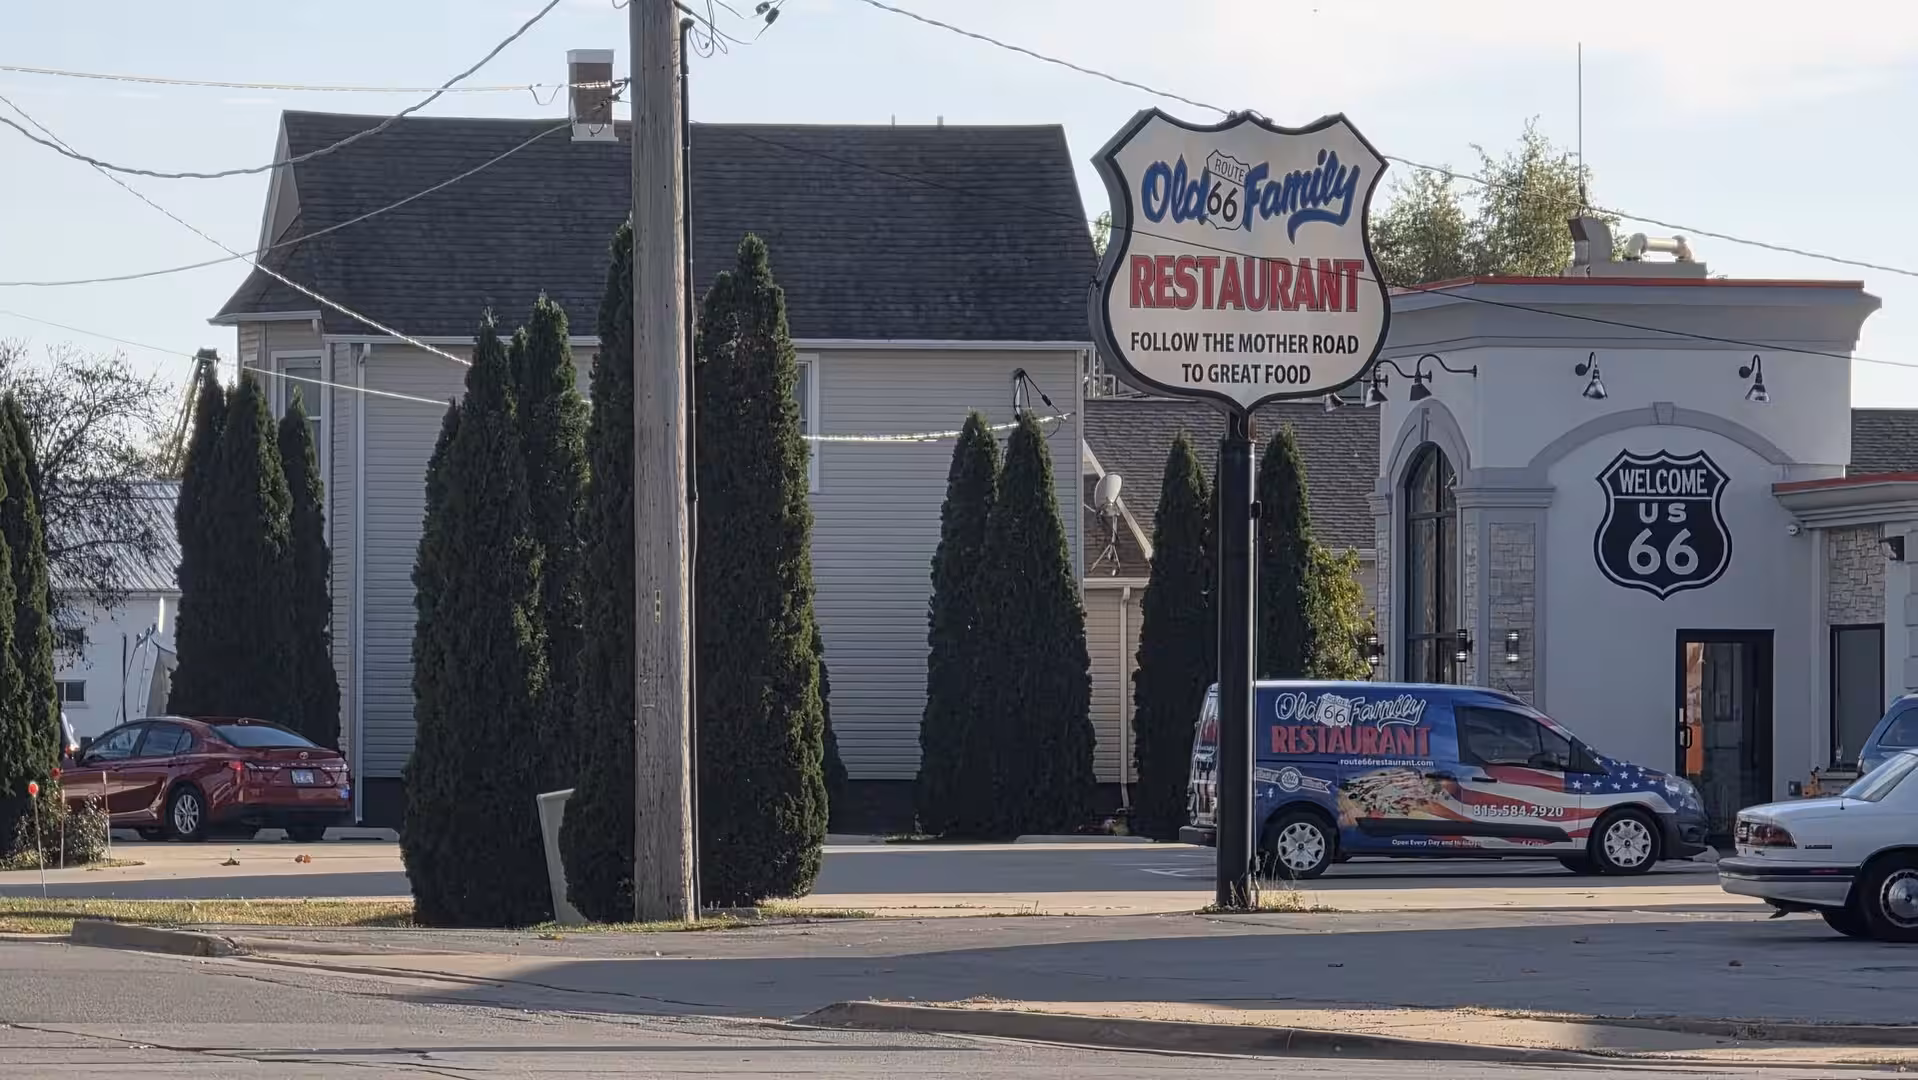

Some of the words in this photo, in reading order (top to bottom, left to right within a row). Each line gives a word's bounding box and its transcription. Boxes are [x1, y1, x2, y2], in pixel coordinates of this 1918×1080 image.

[1214, 158, 1245, 182] ROUTE
[1141, 153, 1210, 225] Old
[1243, 149, 1360, 244] Family
[1207, 180, 1238, 223] 66
[1130, 254, 1364, 313] RESTAURANT
[1131, 332, 1199, 352] FOLLOW
[1203, 333, 1234, 352] THE
[1239, 333, 1308, 354] MOTHER
[1313, 335, 1359, 354] ROAD
[1182, 363, 1204, 383] TO
[1208, 364, 1261, 383] GREAT
[1265, 365, 1311, 384] FOOD
[1619, 468, 1708, 494] WELCOME
[1628, 528, 1698, 575] 66
[1275, 692, 1321, 723] Old
[1324, 705, 1346, 724] 66
[1349, 694, 1426, 733] Family
[1272, 725, 1431, 755] RESTAURANT
[1340, 758, 1434, 767] route66restaurant.com
[1473, 804, 1563, 817] 815.584.2920
